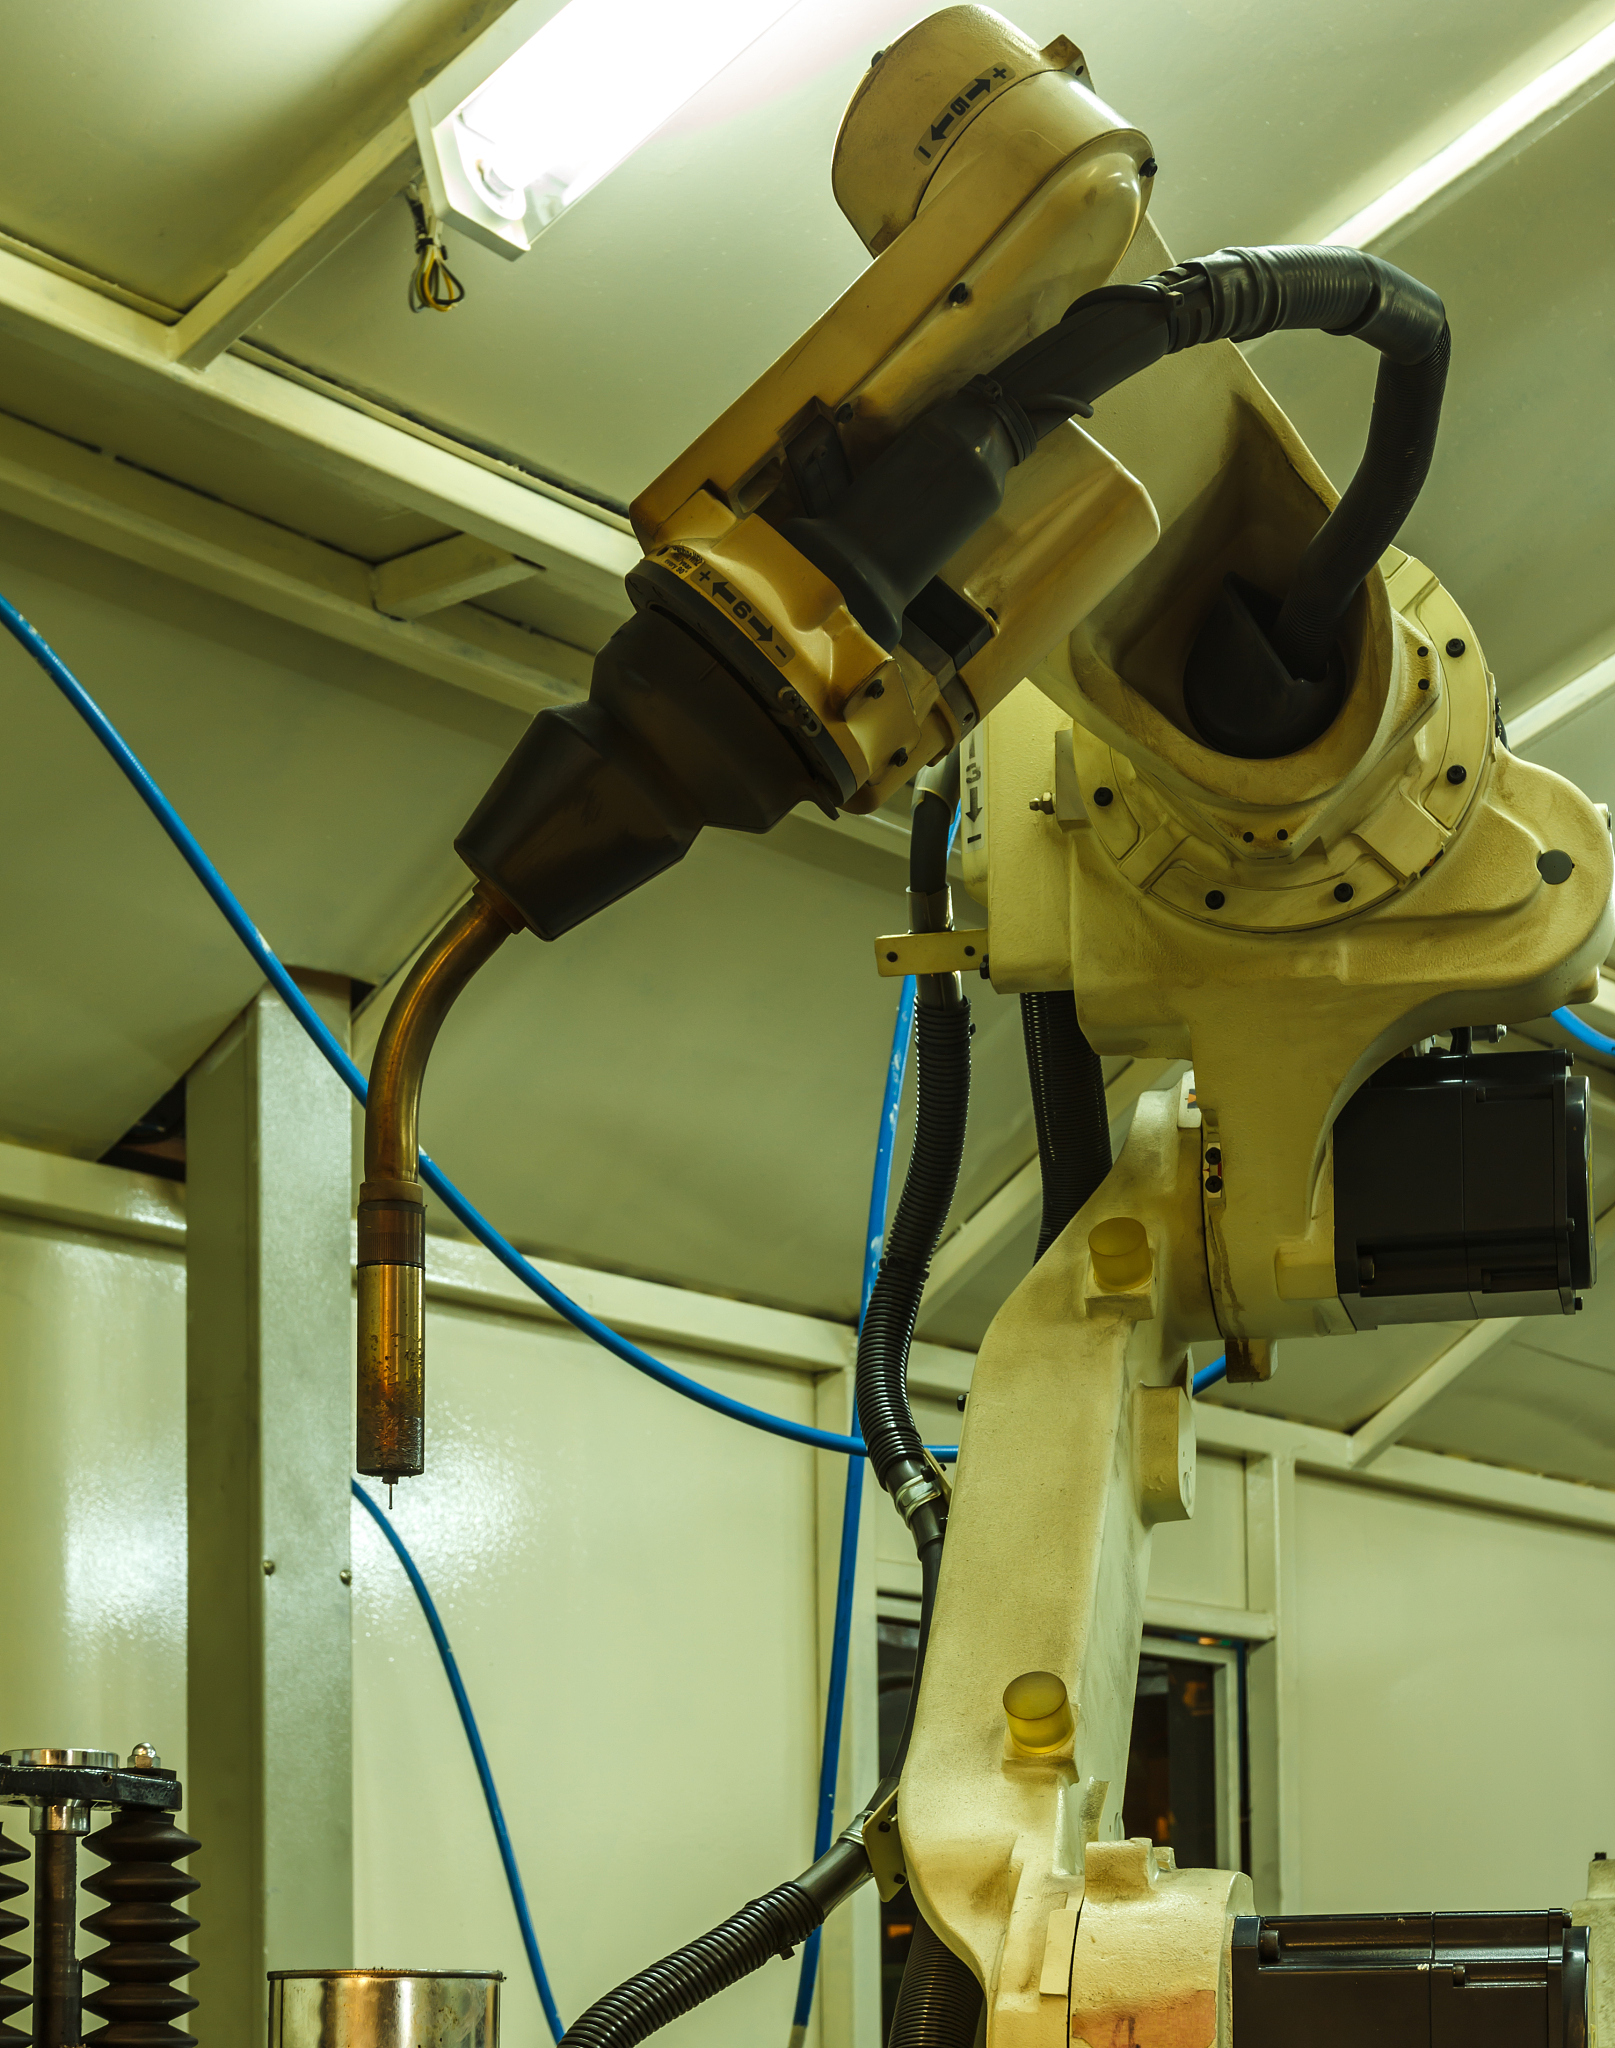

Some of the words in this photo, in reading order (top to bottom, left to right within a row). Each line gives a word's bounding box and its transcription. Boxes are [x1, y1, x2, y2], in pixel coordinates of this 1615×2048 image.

[950, 96, 970, 116] 5
[732, 600, 752, 619] 6
[966, 762, 981, 784] 3
